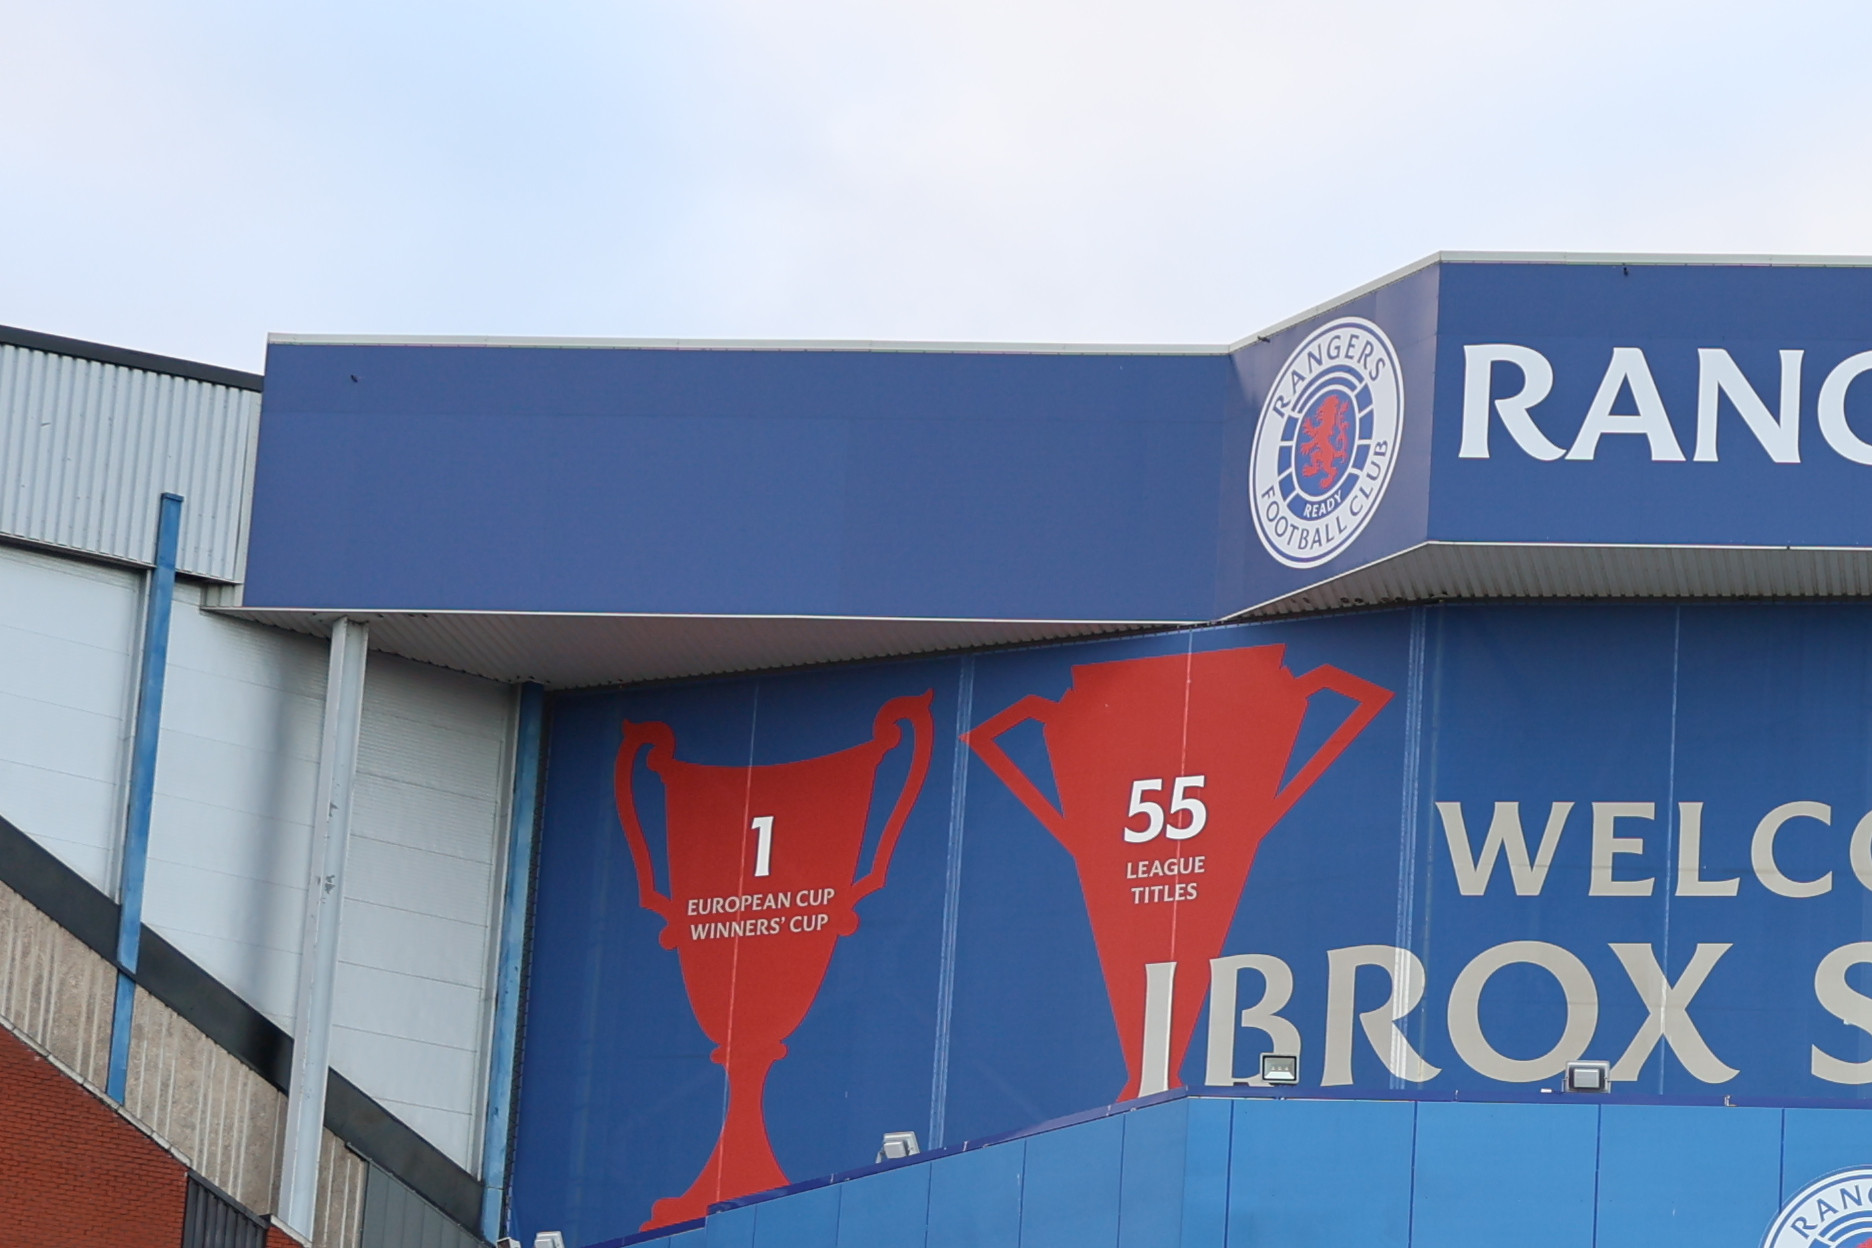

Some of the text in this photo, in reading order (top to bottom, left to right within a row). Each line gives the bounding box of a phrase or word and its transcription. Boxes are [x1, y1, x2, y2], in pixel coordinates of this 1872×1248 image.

[1273, 334, 1386, 419] RANGERS
[1260, 439, 1388, 550] FOOTBALL CLUB
[1303, 489, 1342, 519] READY
[1123, 774, 1207, 844] 55
[751, 815, 775, 877] 1
[1126, 855, 1206, 879] LEAGUE
[687, 888, 835, 916] EUROPEAN CUP
[1130, 882, 1198, 905] TITLES
[690, 914, 829, 941] WINNERS' CUP
[1138, 939, 1741, 1096] IBROX
